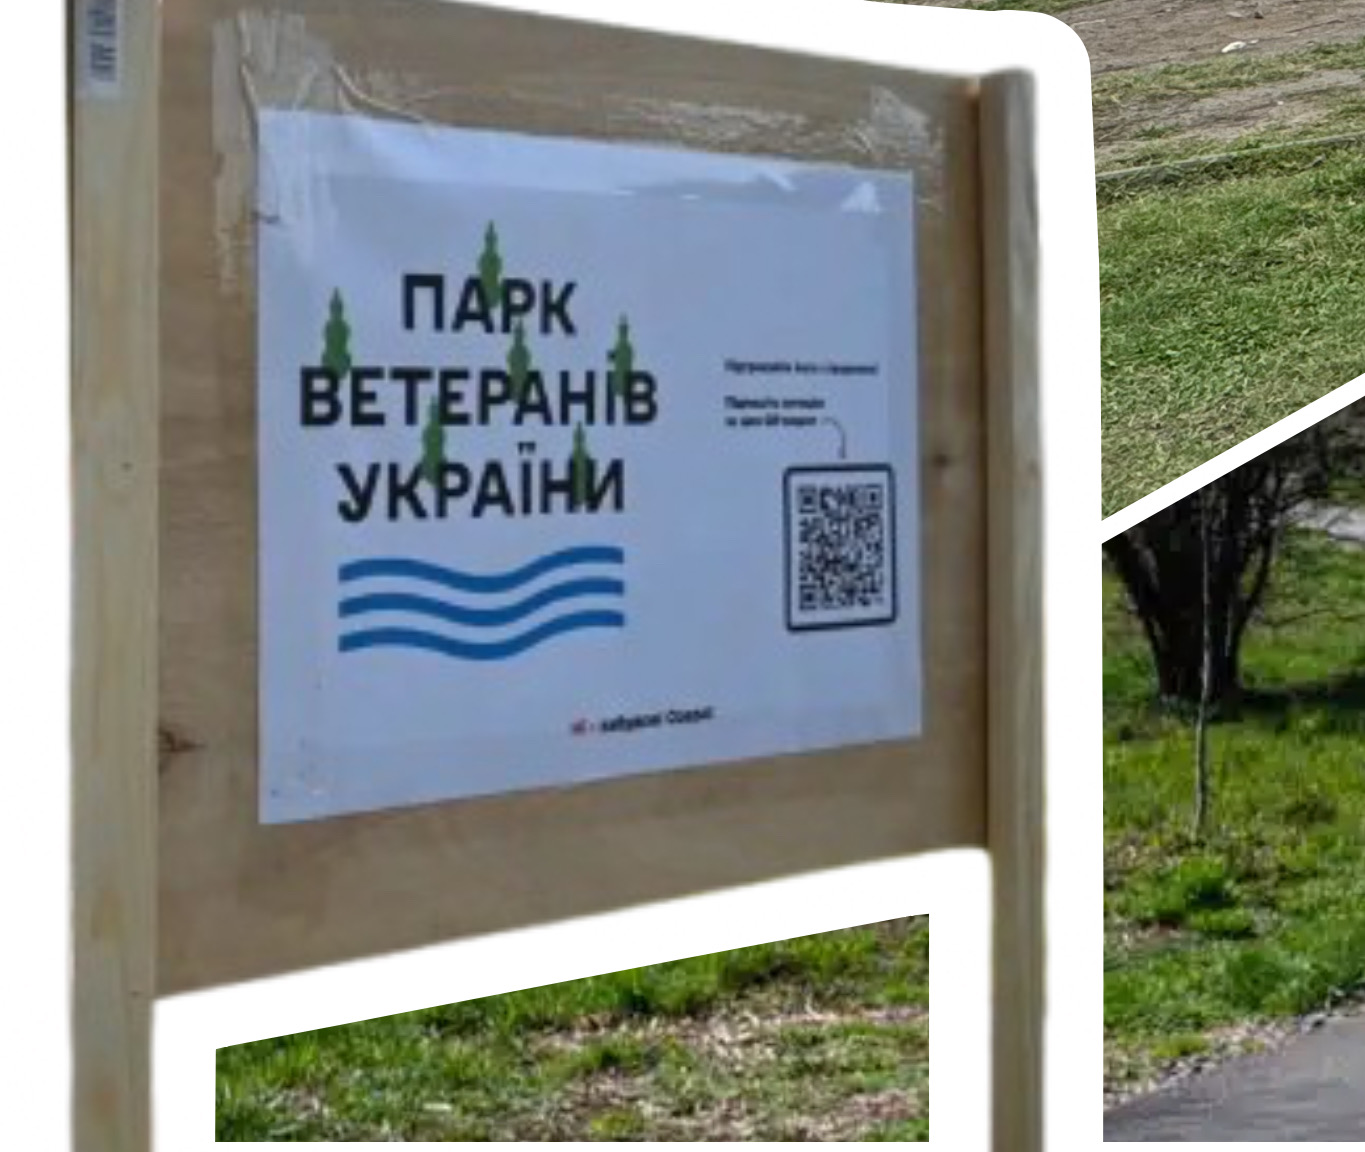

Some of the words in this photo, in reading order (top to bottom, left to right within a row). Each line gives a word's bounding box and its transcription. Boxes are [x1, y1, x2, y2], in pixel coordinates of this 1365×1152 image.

[402, 273, 578, 337] ПАРК
[299, 349, 659, 427] ВЕТЕРАНІВ
[335, 441, 626, 523] УКРАЇНИ
